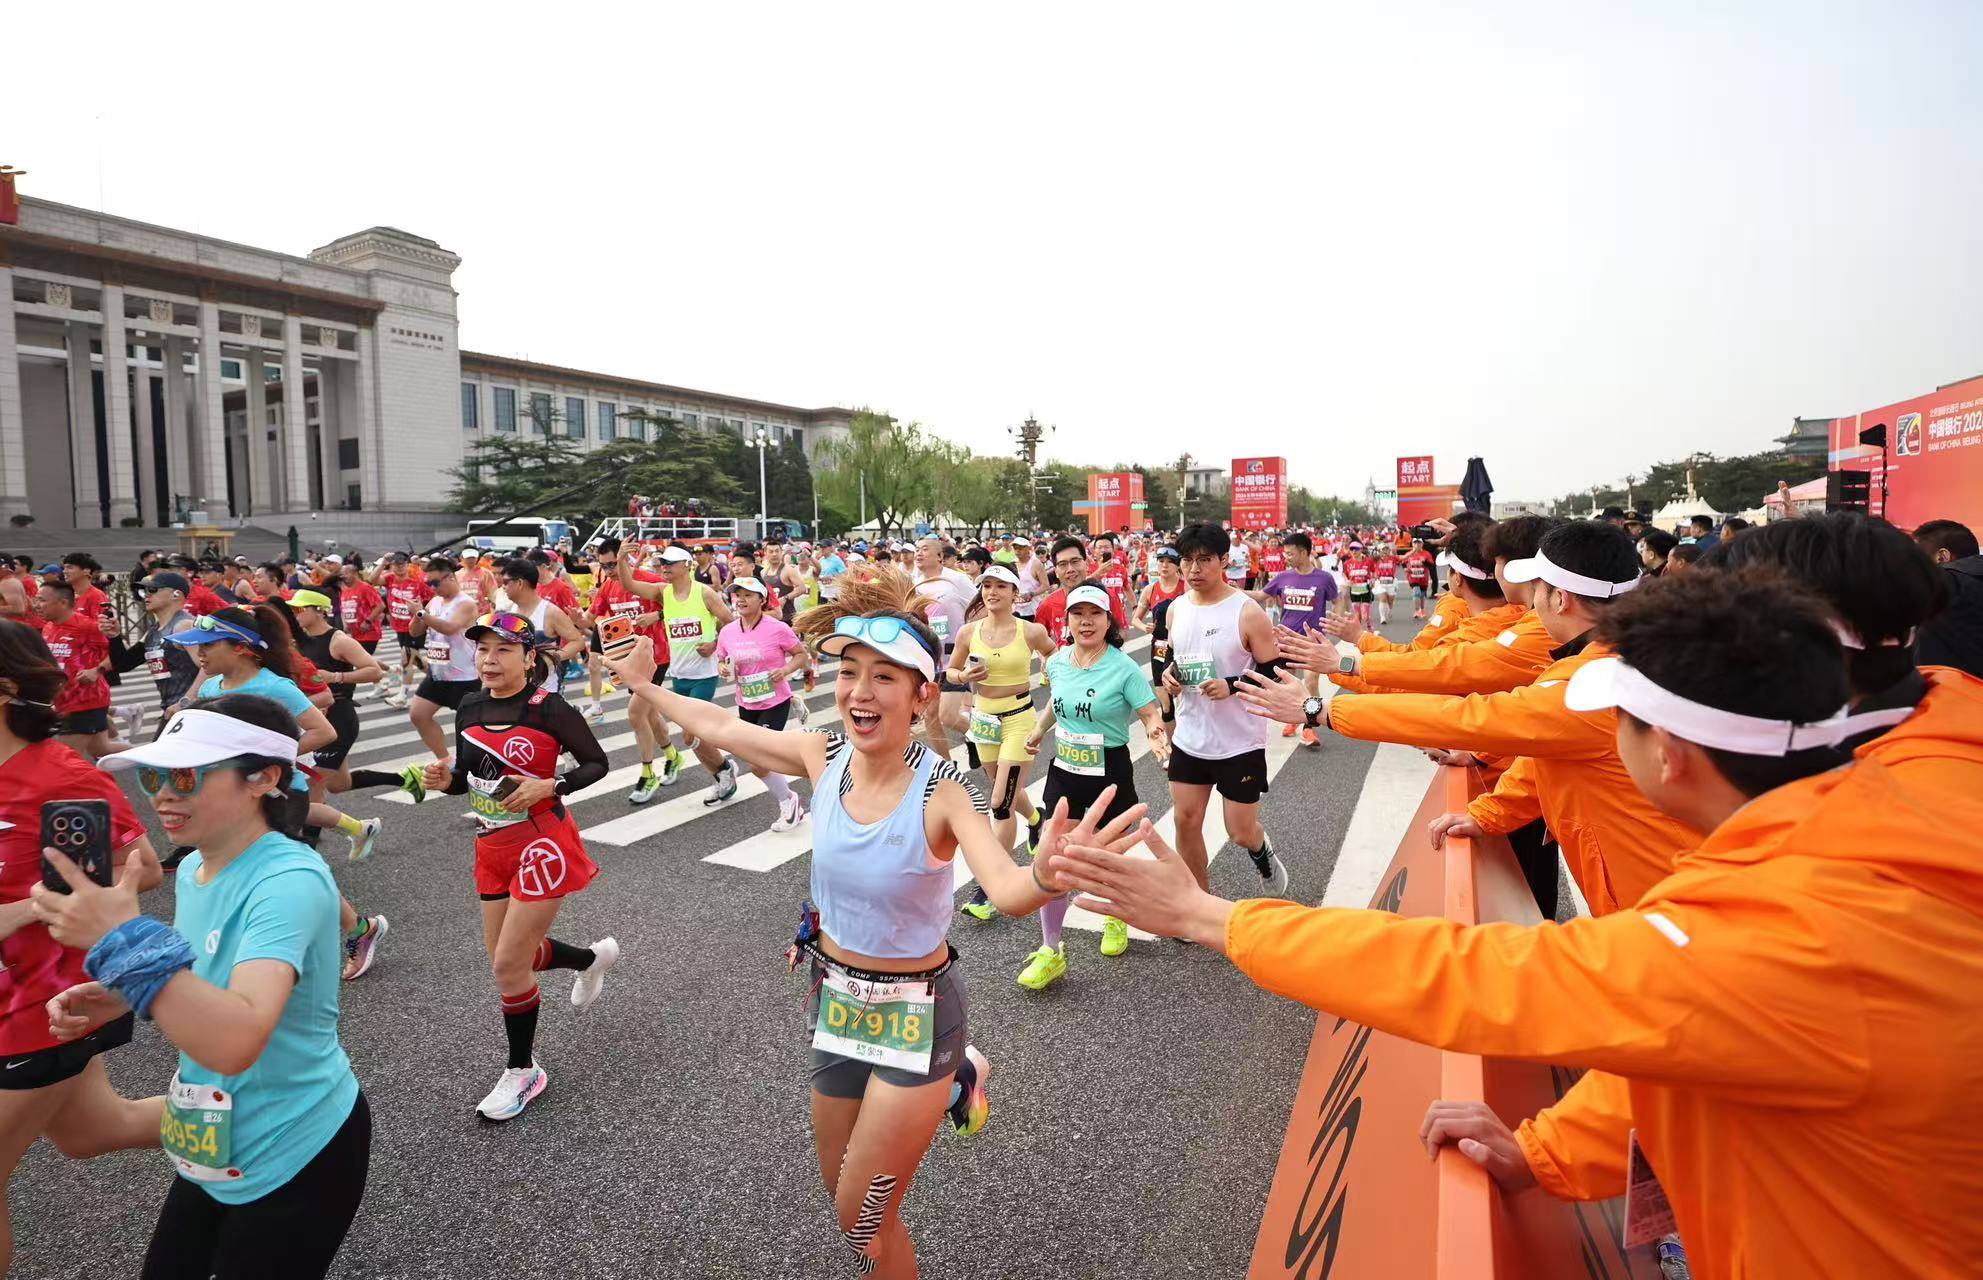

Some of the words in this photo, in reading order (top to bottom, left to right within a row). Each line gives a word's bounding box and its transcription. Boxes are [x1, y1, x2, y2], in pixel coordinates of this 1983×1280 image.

[1928, 416, 1962, 439] 中国银行
[1964, 410, 1983, 432] 202
[1401, 460, 1430, 474] 起点
[1098, 477, 1120, 489] 起点
[1235, 474, 1276, 486] 中国银行
[1401, 475, 1430, 483] START
[1286, 595, 1312, 605] C1717
[671, 624, 699, 636] C4190
[1057, 742, 1099, 763] D7961
[829, 1000, 921, 1042] D7918
